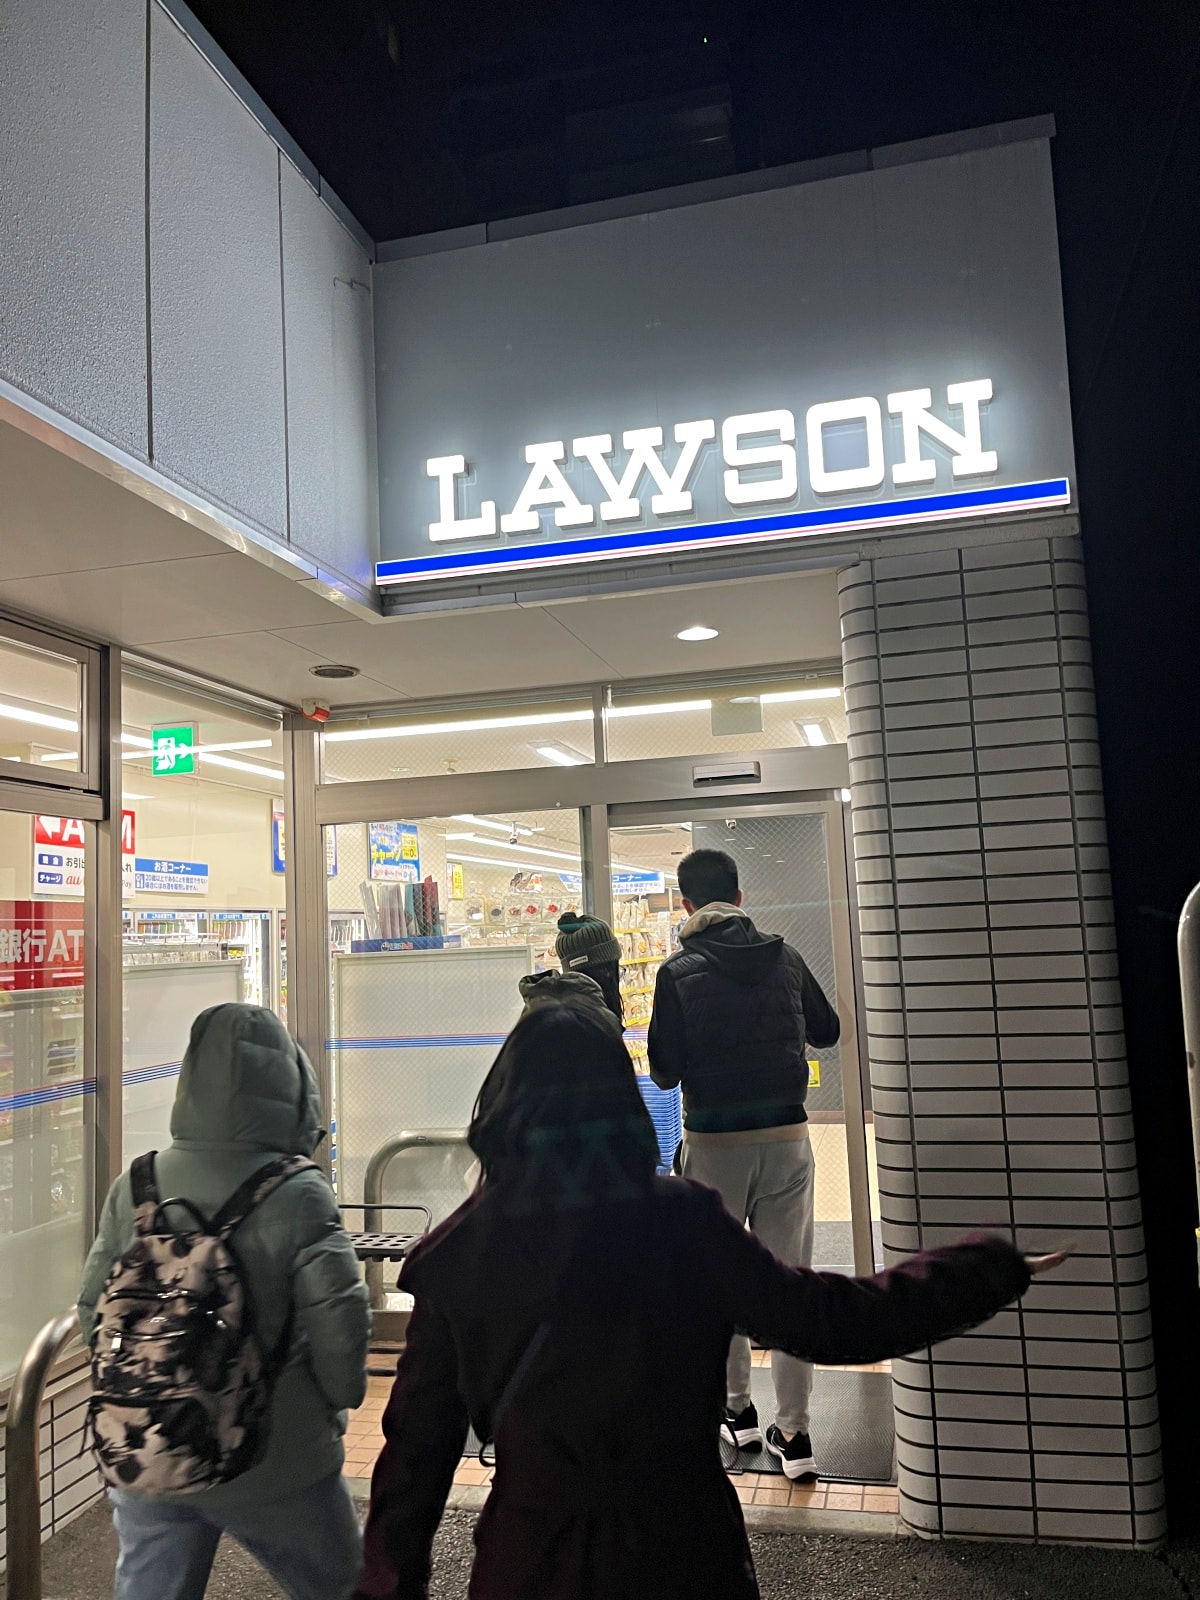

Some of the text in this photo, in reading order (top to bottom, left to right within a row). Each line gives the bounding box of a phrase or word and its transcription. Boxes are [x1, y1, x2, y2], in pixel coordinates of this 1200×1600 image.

[426, 377, 998, 543] LAWSON
[39, 874, 62, 883] チャージ
